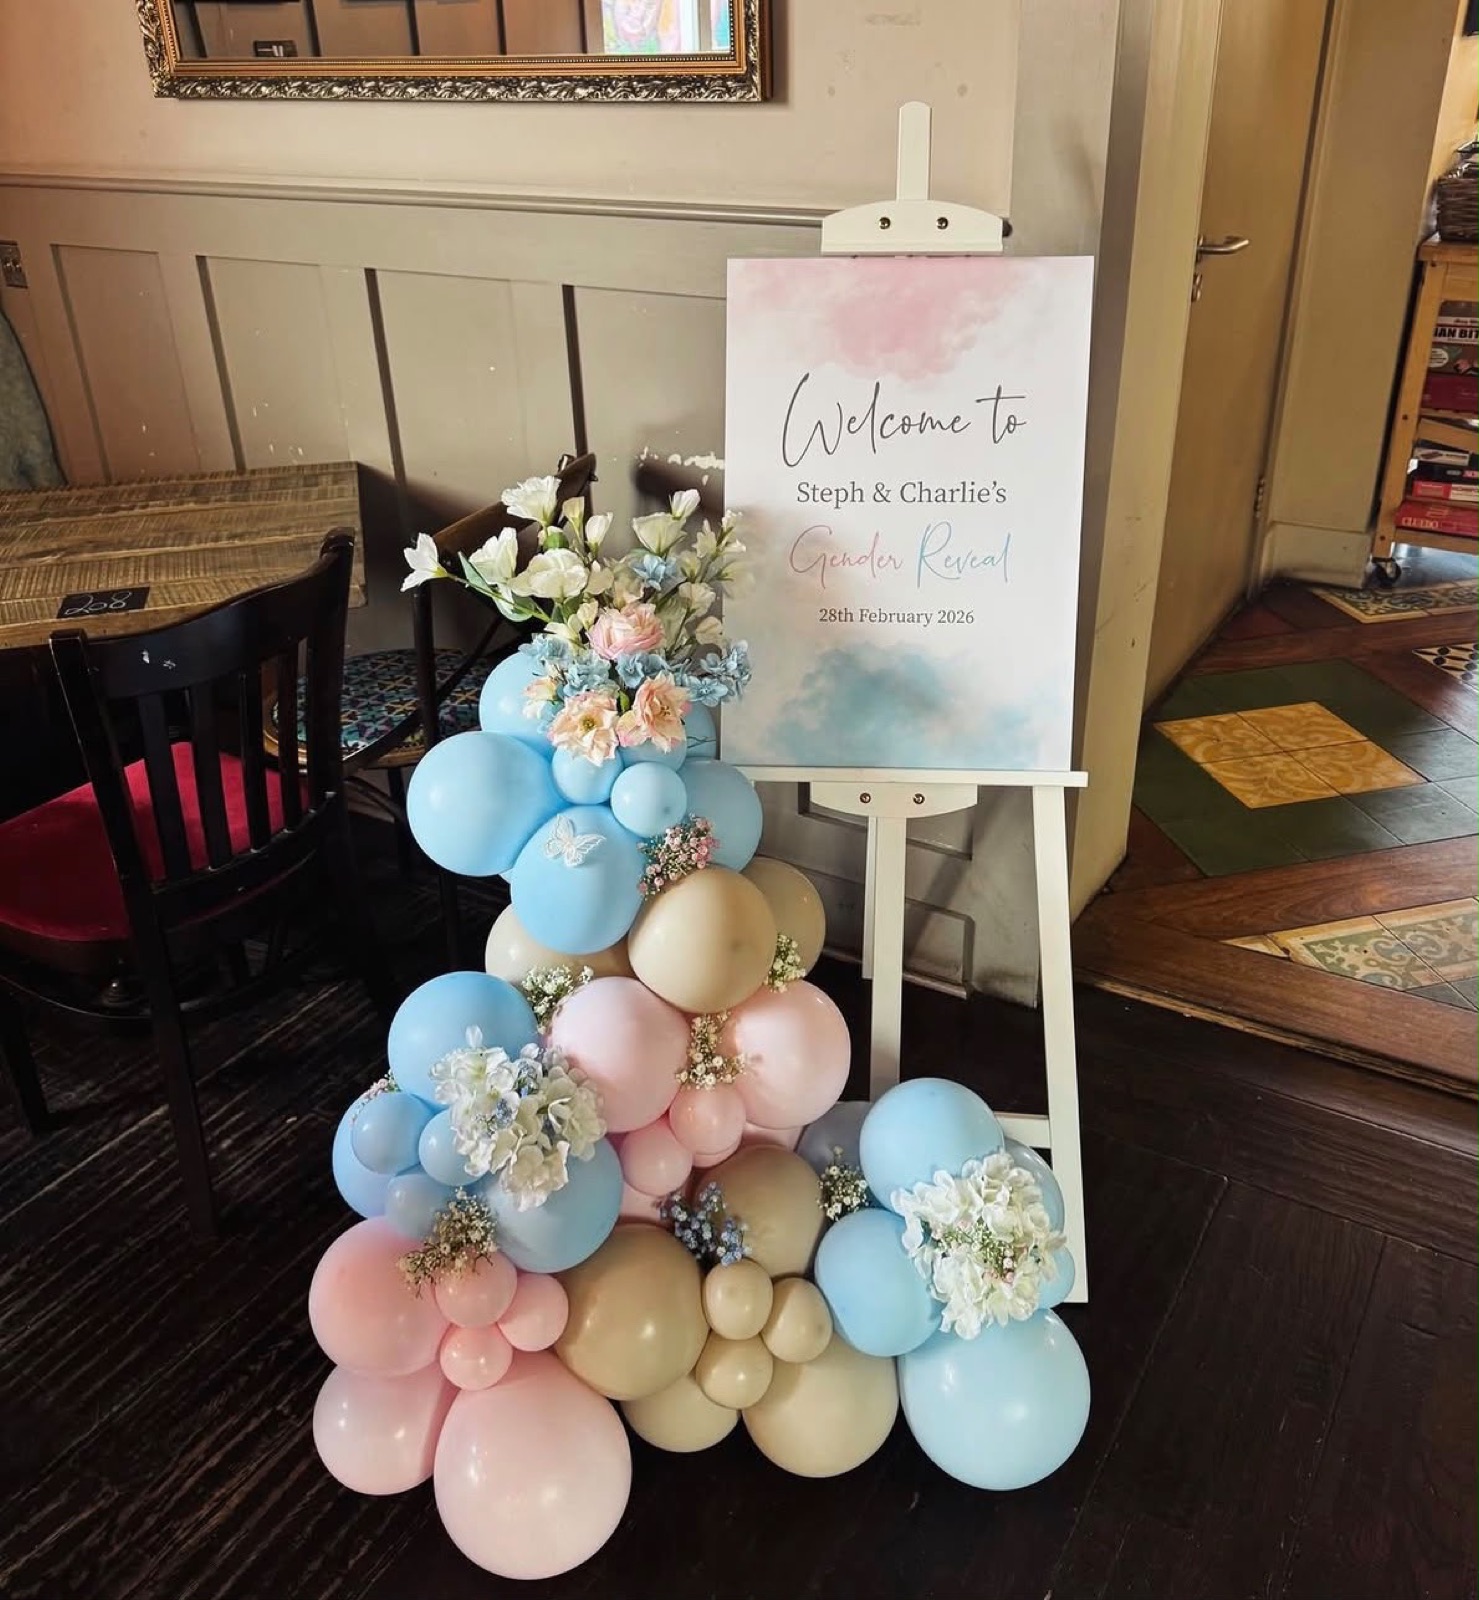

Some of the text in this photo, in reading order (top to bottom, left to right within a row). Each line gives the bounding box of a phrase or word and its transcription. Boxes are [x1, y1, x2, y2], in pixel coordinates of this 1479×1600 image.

[781, 372, 1027, 468] Welcome to
[797, 480, 1007, 509] Steph & Charlie’s
[788, 521, 1012, 590] Gender Reveal
[64, 591, 132, 616] 208
[819, 607, 975, 628] 28th February 2026
